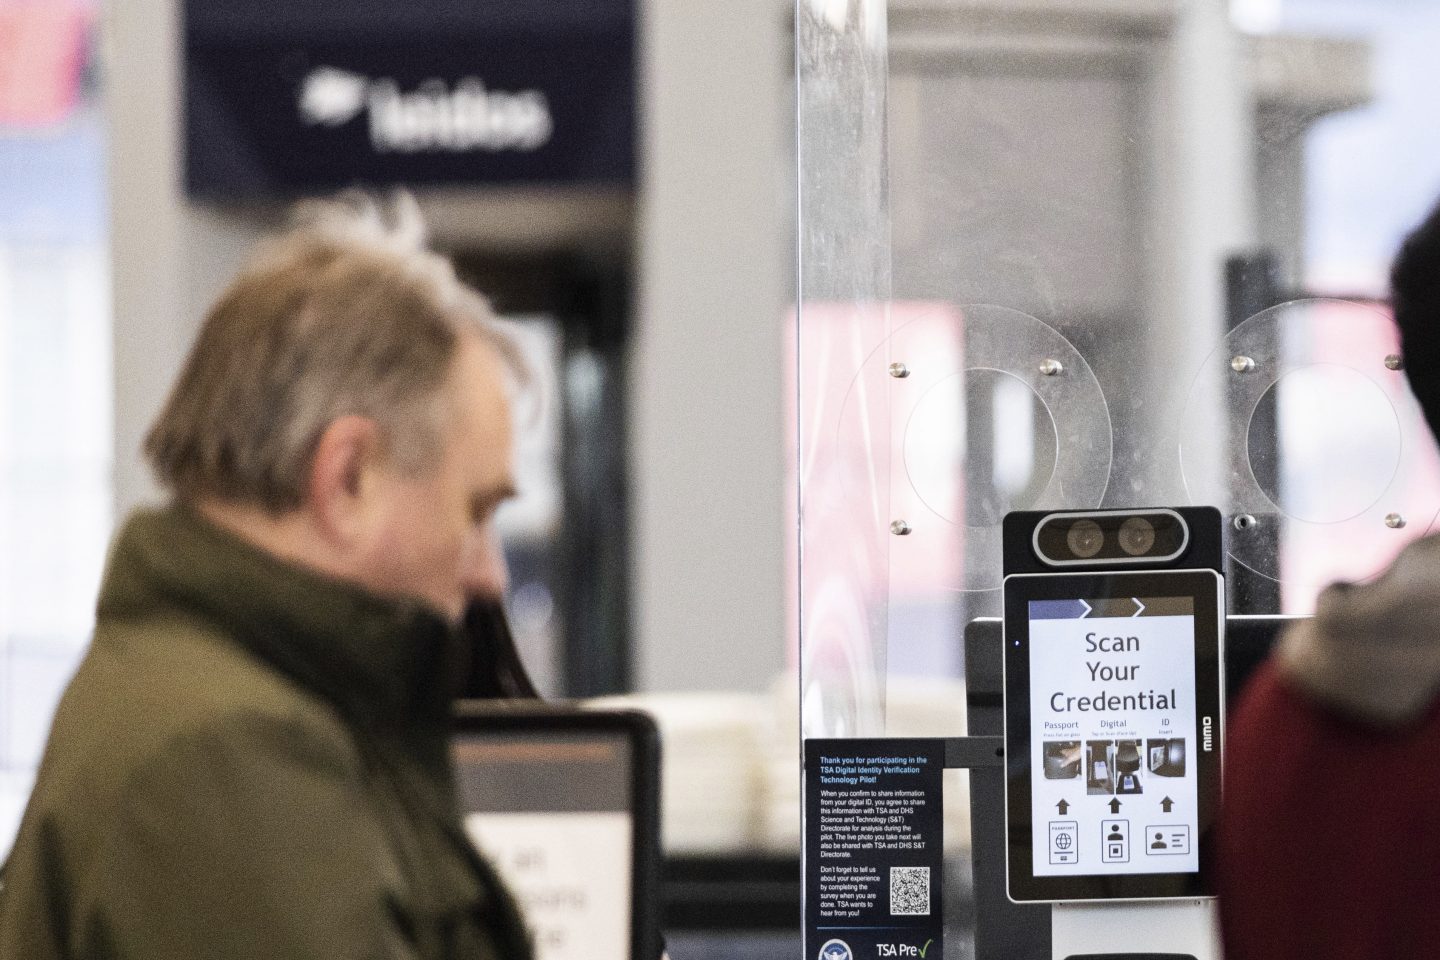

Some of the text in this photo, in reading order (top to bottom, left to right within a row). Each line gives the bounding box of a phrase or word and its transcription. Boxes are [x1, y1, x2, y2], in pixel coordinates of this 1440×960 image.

[1085, 632, 1140, 653] Scan
[1086, 661, 1140, 682] Your
[1050, 689, 1176, 712] Credential
[1044, 721, 1079, 730] Passport
[1100, 720, 1127, 729] Digital
[1162, 718, 1169, 726] ID
[1203, 716, 1212, 752] mimo
[867, 757, 907, 765] participating
[835, 767, 856, 775] Digital
[858, 767, 882, 775] Identity
[820, 776, 858, 784] Technology
[848, 799, 864, 807] digital
[856, 816, 886, 824] Technology
[836, 866, 852, 874] forget
[876, 944, 917, 956] TSA Pre
